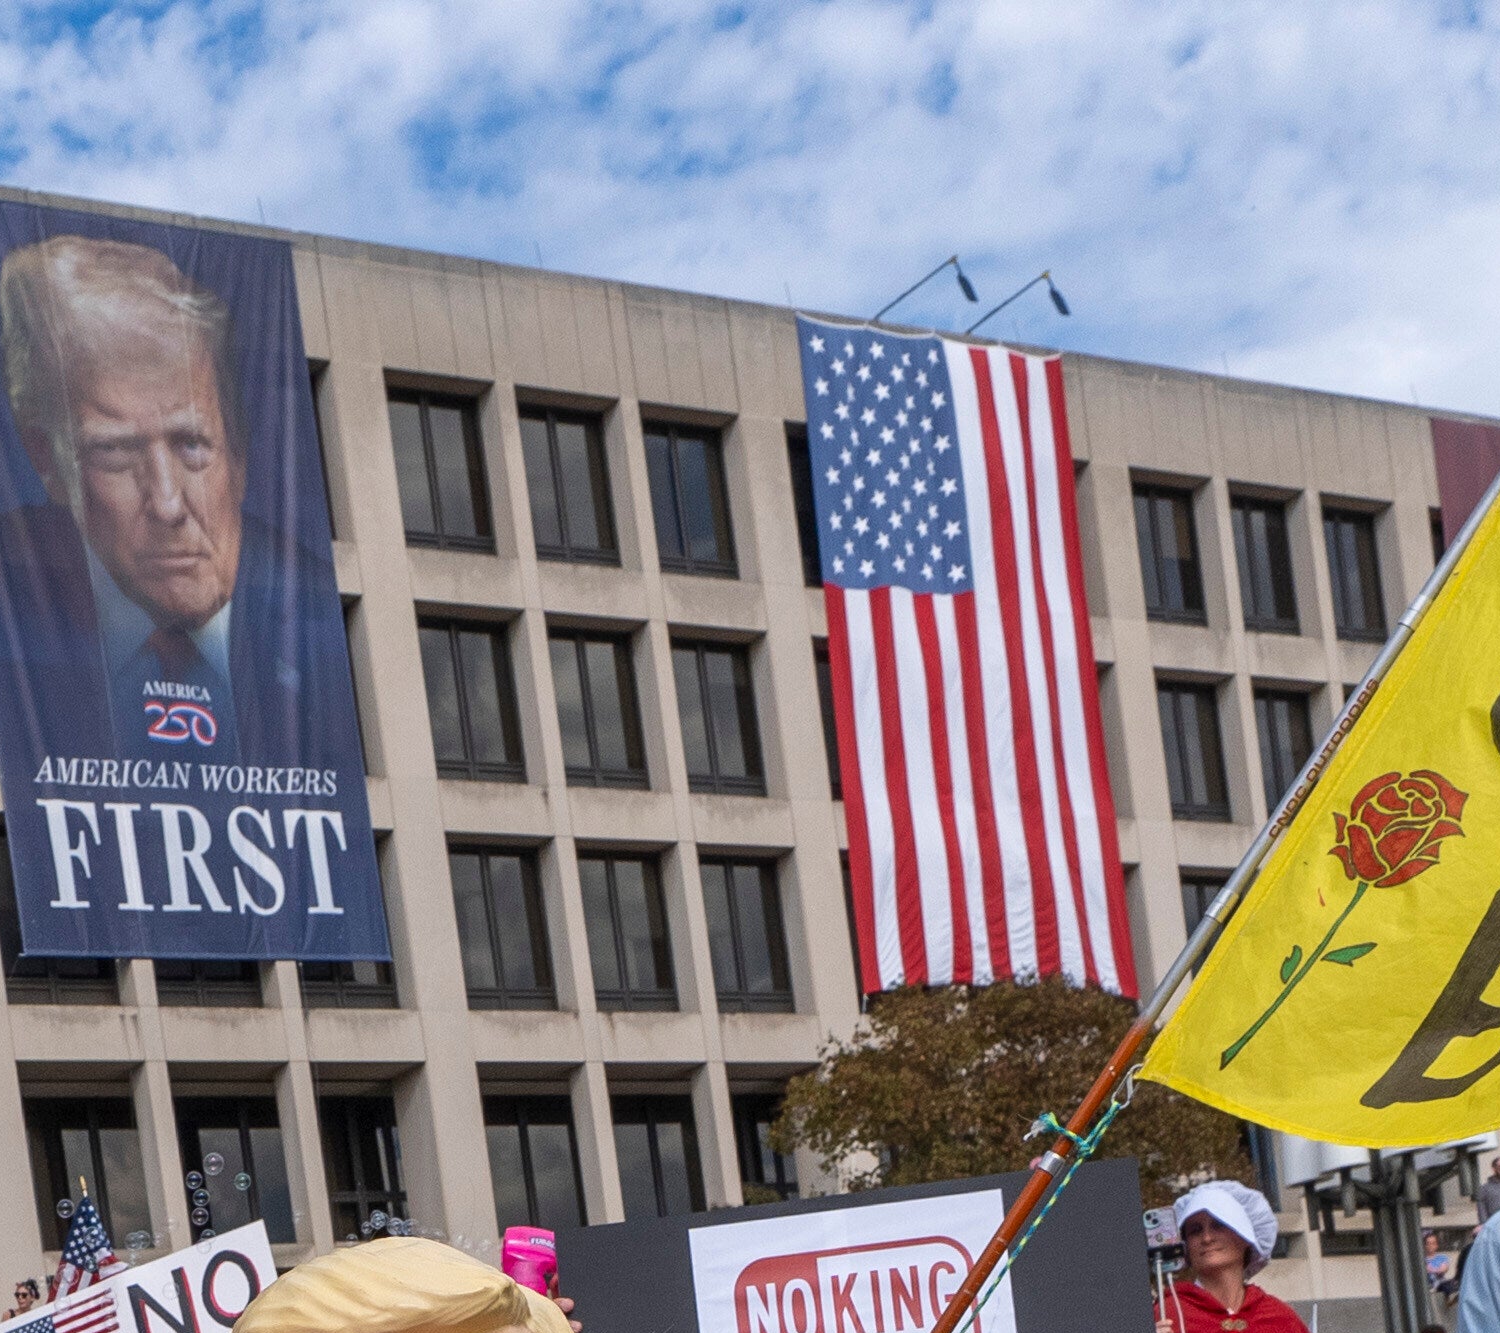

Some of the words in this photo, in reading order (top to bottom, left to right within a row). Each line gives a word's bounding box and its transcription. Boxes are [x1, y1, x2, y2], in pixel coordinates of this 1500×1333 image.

[143, 681, 211, 701] AMERICA
[144, 700, 218, 746] 250
[1306, 678, 1378, 783] OUTDOORS
[34, 756, 190, 789] AMERICAN
[199, 764, 338, 796] WORKERS
[36, 798, 347, 916] FIRST
